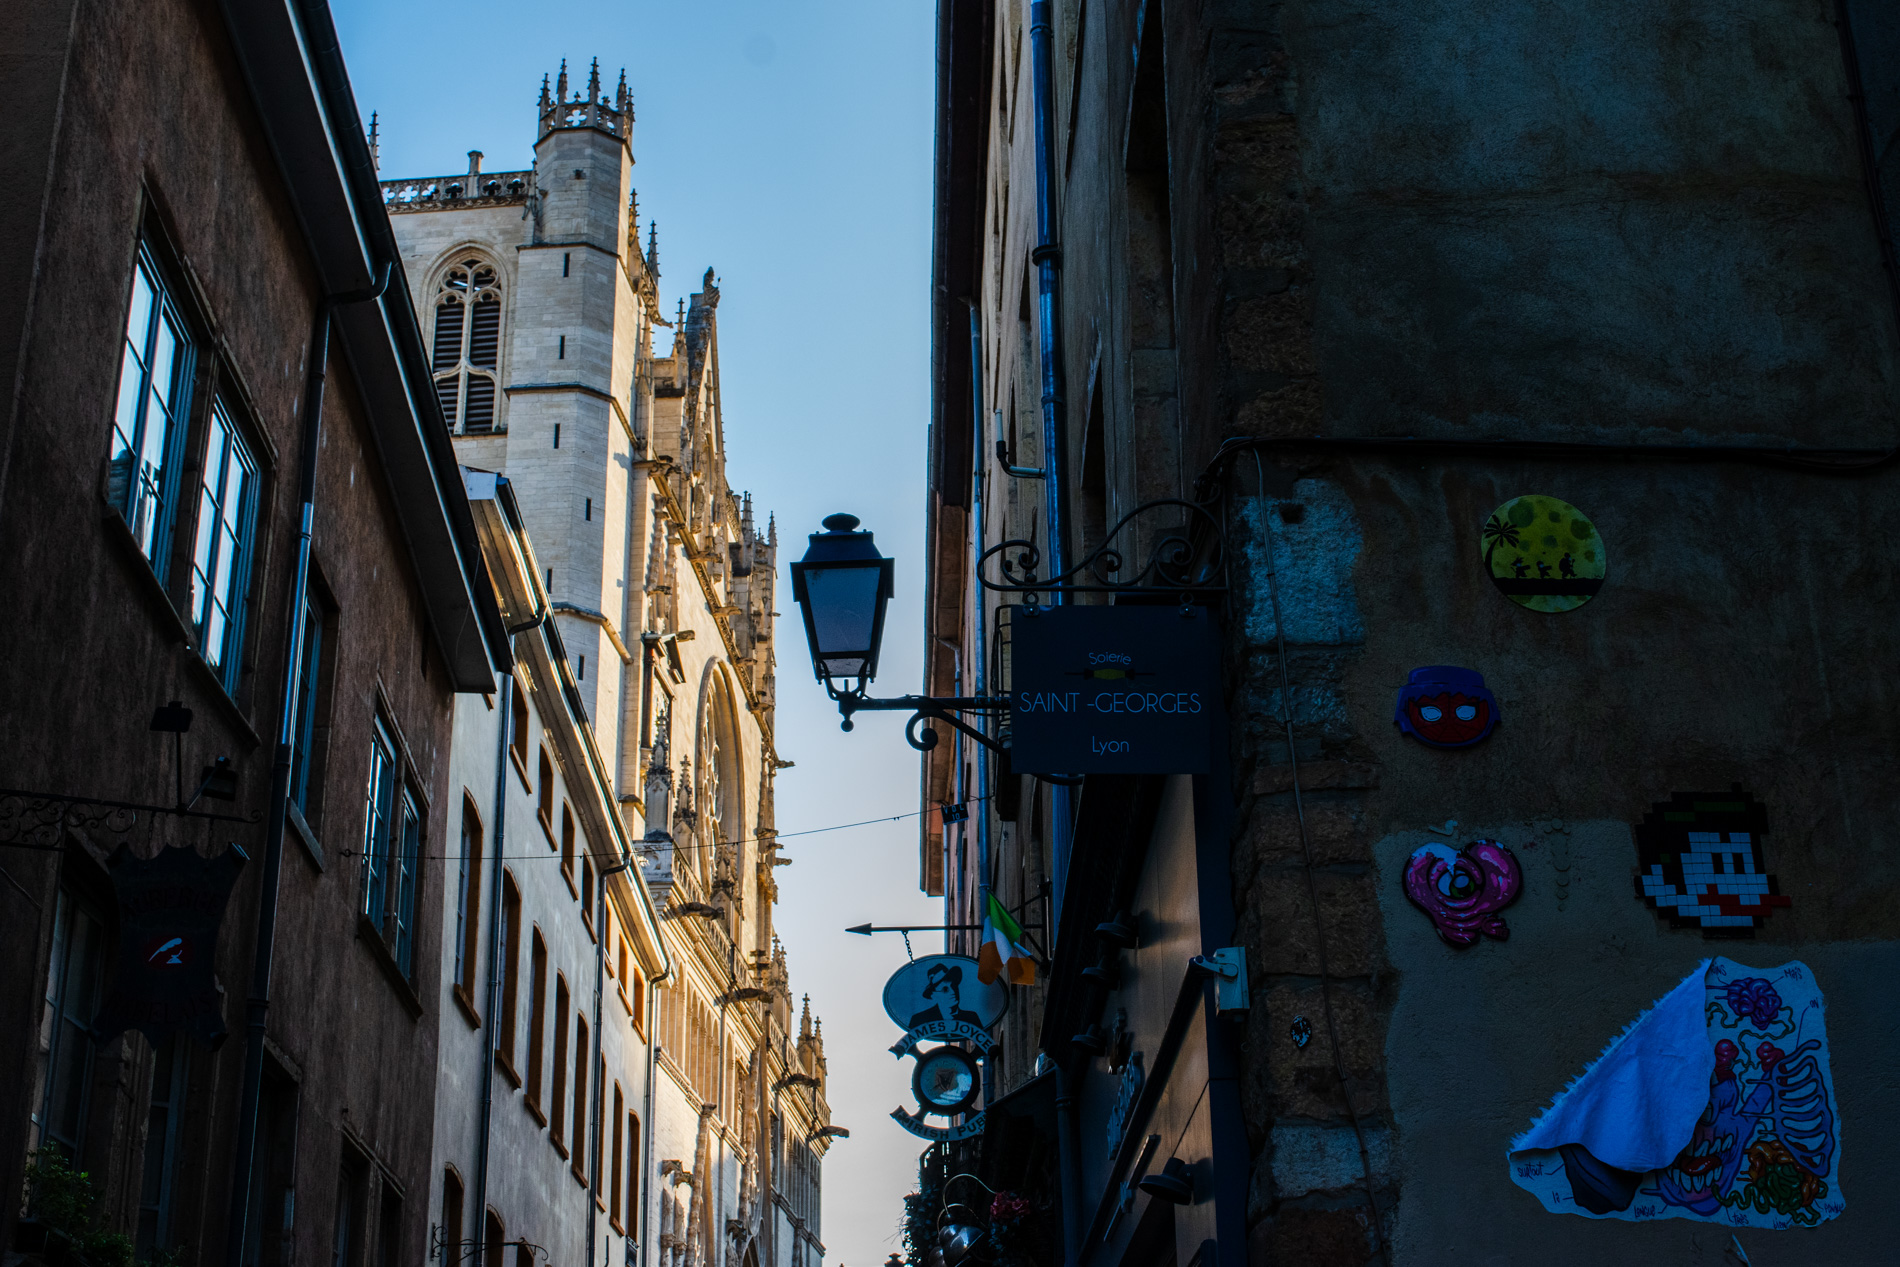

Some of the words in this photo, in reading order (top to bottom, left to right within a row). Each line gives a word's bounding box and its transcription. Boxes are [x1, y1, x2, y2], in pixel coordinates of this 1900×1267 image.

[1088, 652, 1132, 666] Soierie
[1019, 692, 1080, 713] SAINT
[1092, 735, 1130, 756] Lyon
[120, 884, 223, 917] AUBERGE
[105, 989, 214, 1024] RABELAIS
[903, 1021, 946, 1049] JAMES
[952, 1021, 992, 1050] JOYCE
[906, 1118, 949, 1139] IRISH
[957, 1117, 985, 1137] PUB
